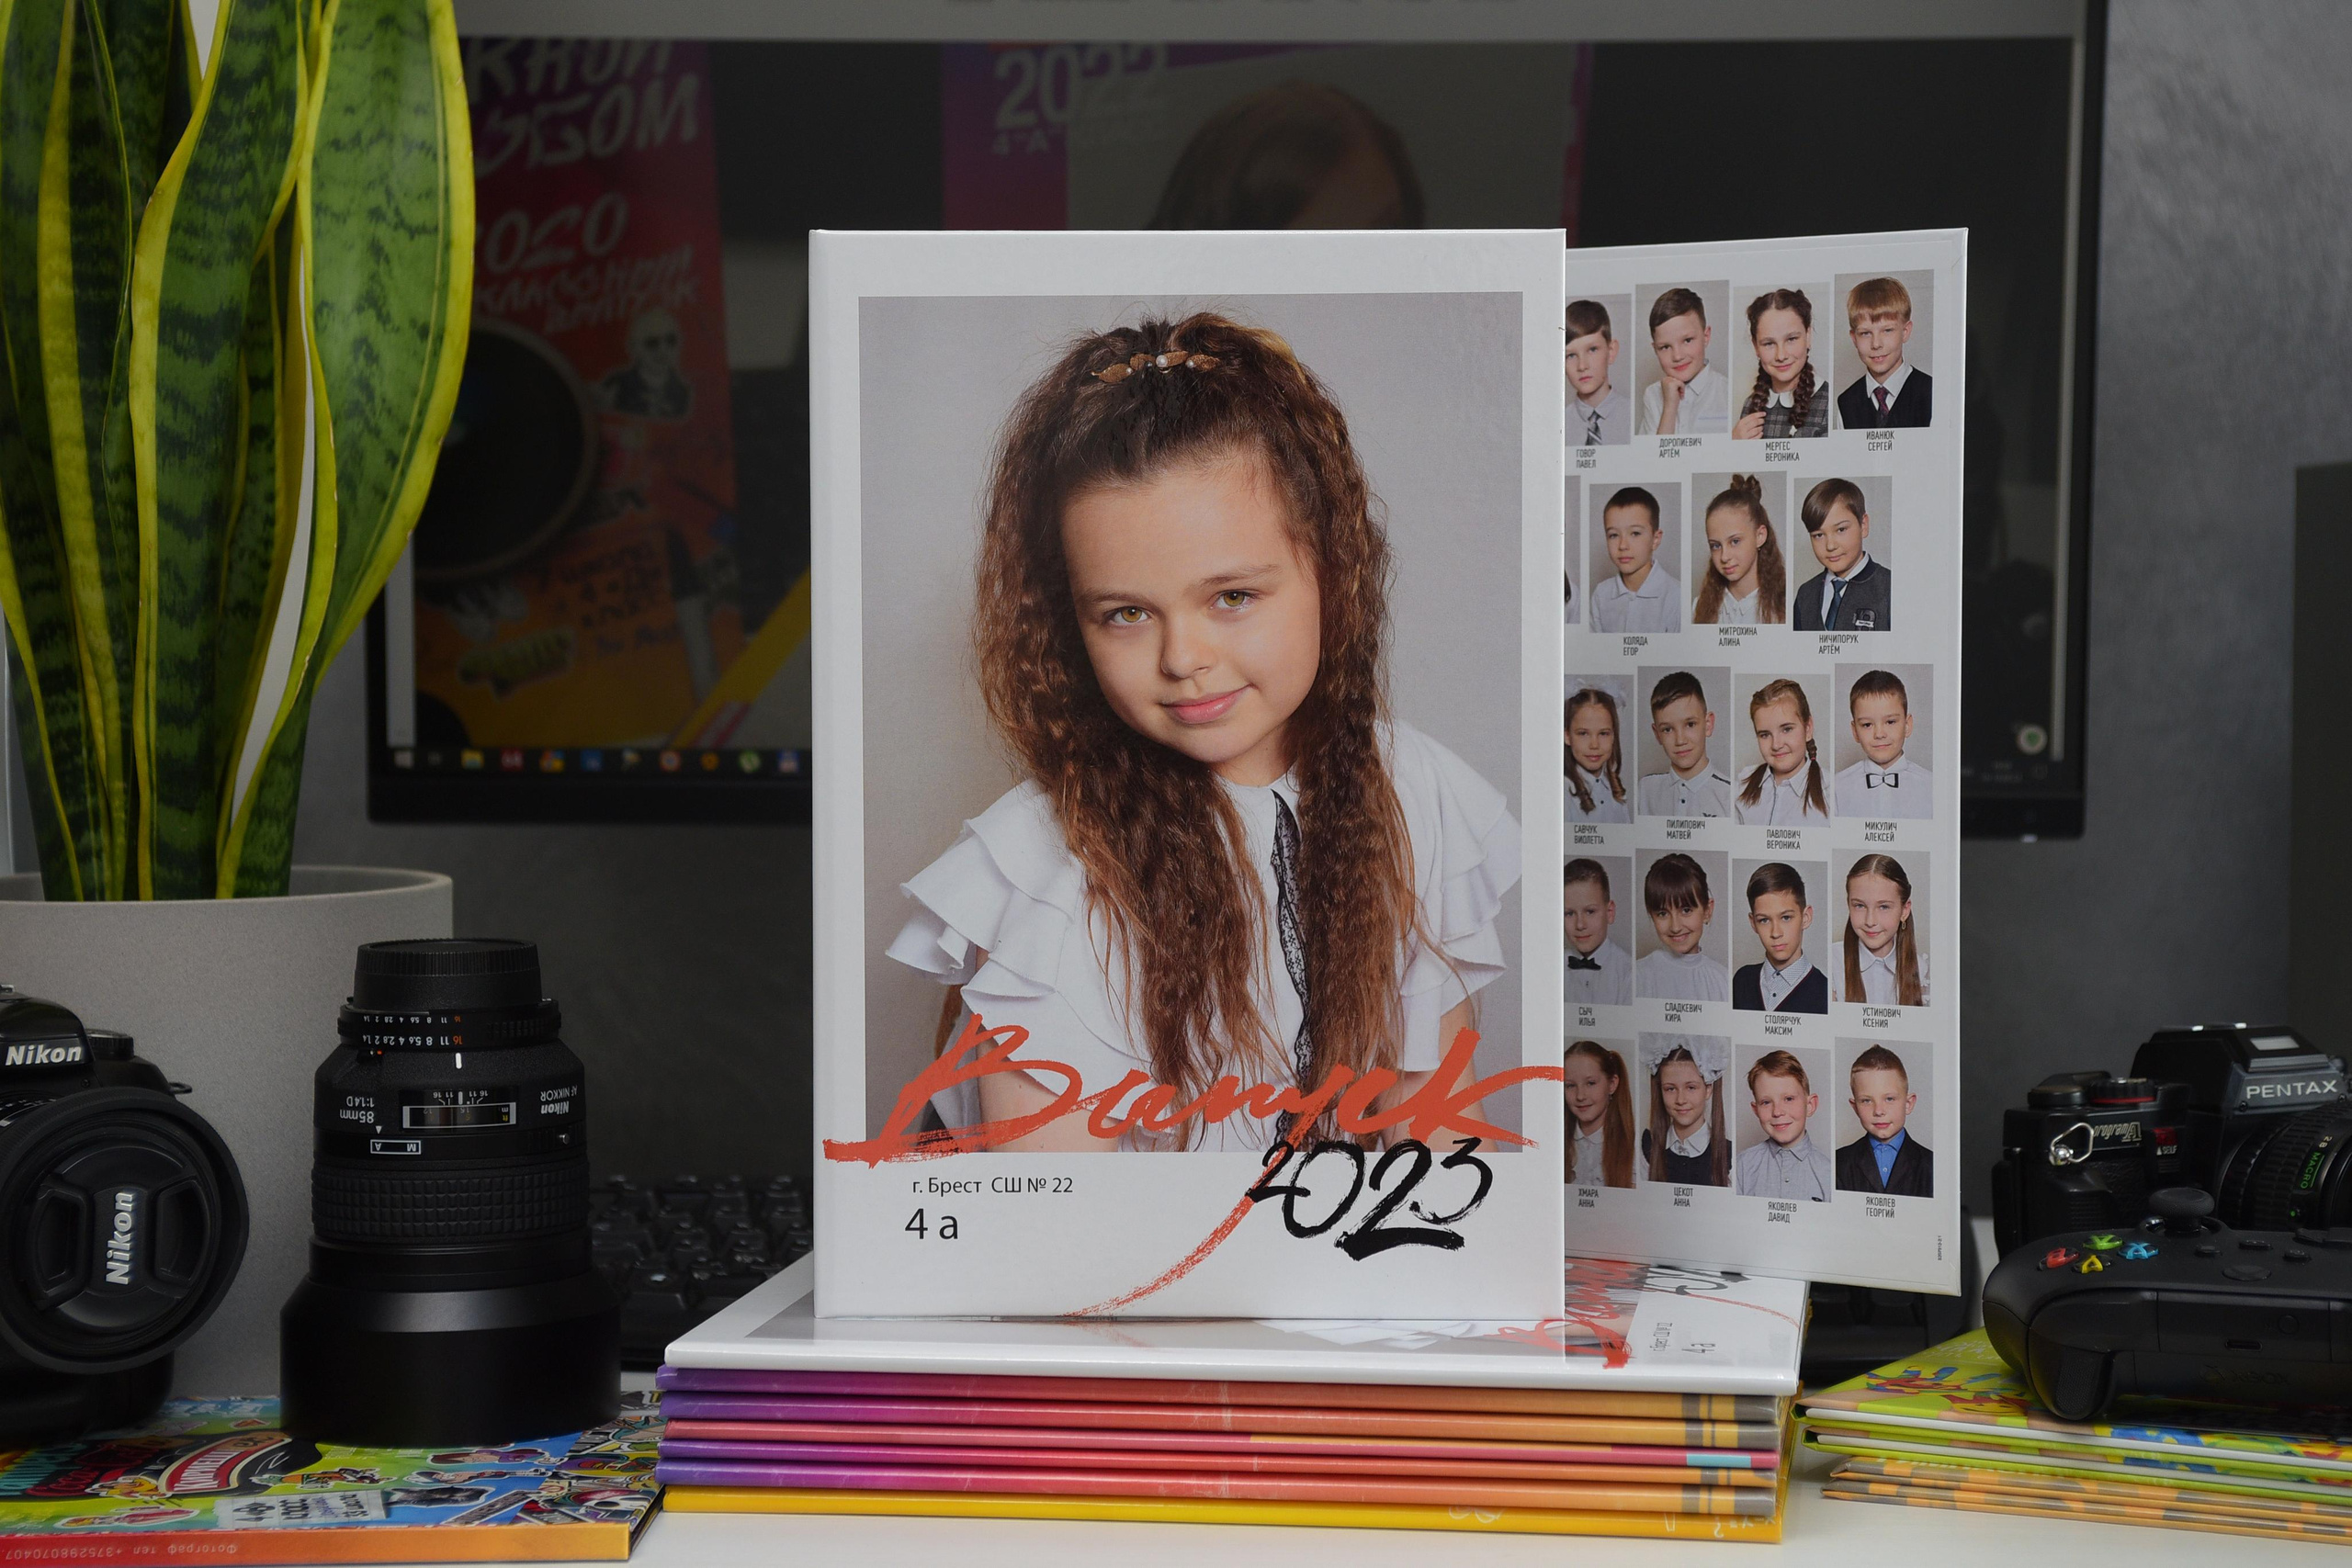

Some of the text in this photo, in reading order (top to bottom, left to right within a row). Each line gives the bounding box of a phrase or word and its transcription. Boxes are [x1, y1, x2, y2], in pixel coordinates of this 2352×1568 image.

[1866, 431, 1894, 440] ИВАНЮК
[1659, 437, 1702, 448] ДОРОПИЕВИЧ
[1765, 441, 1791, 450] МЕРГЕС
[1868, 441, 1893, 451] СЕРГЕЙ
[1577, 449, 1596, 457] ГОВОР
[1659, 448, 1679, 457] АРТЁМ
[1765, 452, 1800, 461] ВЕРОНИКА
[1577, 459, 1596, 468] ПАВЕЛ
[1719, 626, 1758, 636] МИТРОХИНА
[1623, 636, 1648, 646] КОЛЯДА
[1718, 637, 1741, 647] АЛИНА
[1819, 634, 1859, 643] НИЧИПОРУК
[1623, 647, 1639, 656] ЕГОР
[1818, 644, 1840, 654] АРТЁМ
[1667, 819, 1705, 829] ПИЛИПОВИЧ
[1865, 821, 1897, 831] МИКУЛИЧ
[1575, 825, 1597, 834] САВЧУК
[1667, 829, 1691, 840] МАТВЕЙ
[1766, 829, 1801, 839] ПАВЛОВИЧ
[1575, 836, 1604, 845] ВИОЛЕТТА
[1865, 831, 1894, 841] АЛЕКСЕЙ
[1766, 840, 1801, 850] ВЕРОНИКА
[1578, 1007, 1593, 1016] СЫЧ
[1665, 1003, 1702, 1013] СЛАДКЕВИЧ
[1862, 1007, 1902, 1018] УСТИНОВИЧ
[1578, 1018, 1595, 1027] ИЛЬЯ
[1665, 1013, 1681, 1023] КИРА
[1764, 1014, 1801, 1025] СТОЛЯРЧУК
[1862, 1018, 1889, 1029] КСЕНИЯ
[1764, 1026, 1792, 1036] МАКСИМ
[375, 1036, 380, 1045] 2
[398, 1036, 405, 1045] 4
[409, 1036, 422, 1045] 5.6
[425, 1036, 433, 1045] 8
[440, 1036, 449, 1045] 11
[453, 1036, 463, 1045] 16
[5, 1043, 82, 1066] Nikon
[540, 1088, 571, 1100] NIKKOR
[2246, 1079, 2338, 1100] PENTAX
[541, 1100, 570, 1114] Nikon
[339, 1109, 375, 1123] 85mm
[2162, 1145, 2178, 1155] SELF
[2301, 1151, 2322, 1189] MACRO
[912, 1178, 1073, 1197] г. Брест СШ № 22
[1674, 1187, 1694, 1197] ЦЕКОТ
[1245, 1136, 1494, 1261] 2023
[1578, 1189, 1599, 1198] ХМАРА
[1578, 1199, 1595, 1208] АННА
[1674, 1198, 1690, 1207] АННА
[1865, 1196, 1896, 1207] ЯКОВЛЕВ
[1768, 1201, 1797, 1213] ЯКОВЛЕВ
[1866, 1207, 1894, 1218] ГЕОРГИЙ
[1768, 1213, 1790, 1224] ДАВИД
[905, 1209, 958, 1240] 4 а
[106, 1191, 133, 1285] Nikon
[167, 1544, 237, 1555] Фотограф
